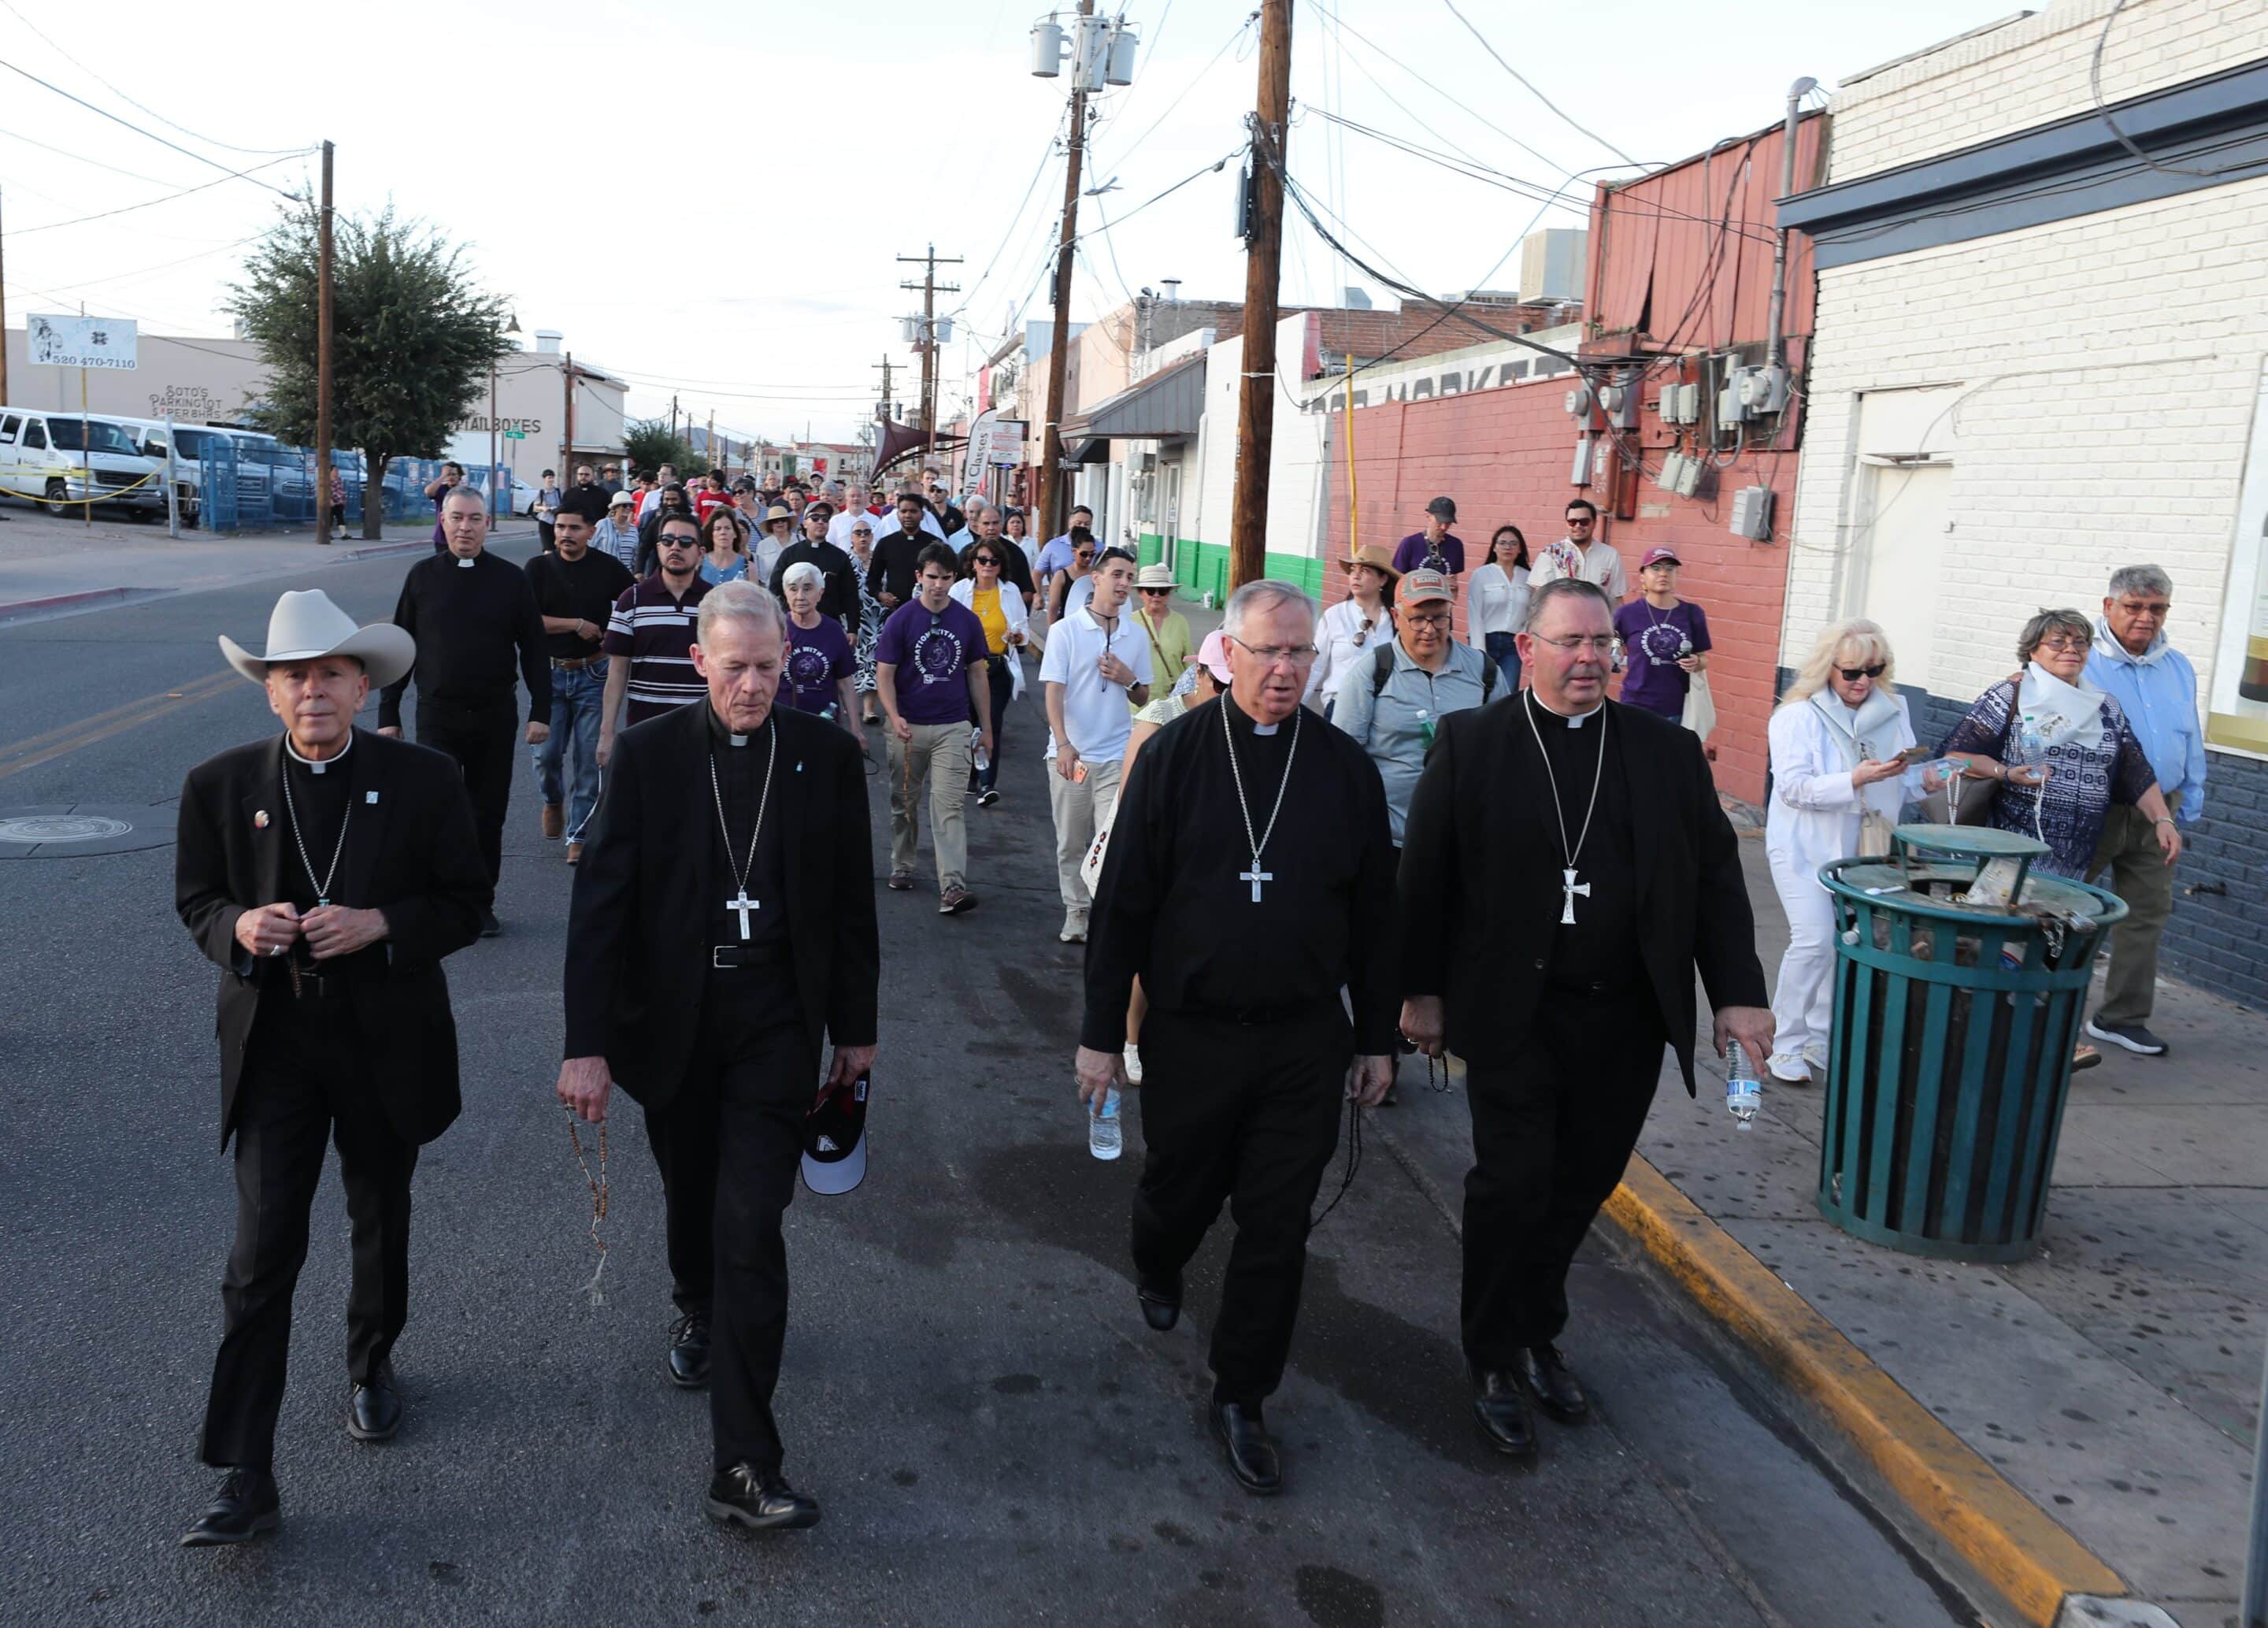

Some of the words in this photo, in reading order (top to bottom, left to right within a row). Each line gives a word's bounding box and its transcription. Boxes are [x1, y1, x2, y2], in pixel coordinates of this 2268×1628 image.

[53, 355, 76, 365] 520
[80, 357, 135, 369] 470-7110
[166, 384, 208, 398] SOTO'S
[150, 394, 202, 408] PARKING
[969, 432, 988, 477] Classes
[802, 647, 824, 657] WITH
[914, 631, 931, 674] MIGRATION
[947, 640, 962, 674] DIGNITY
